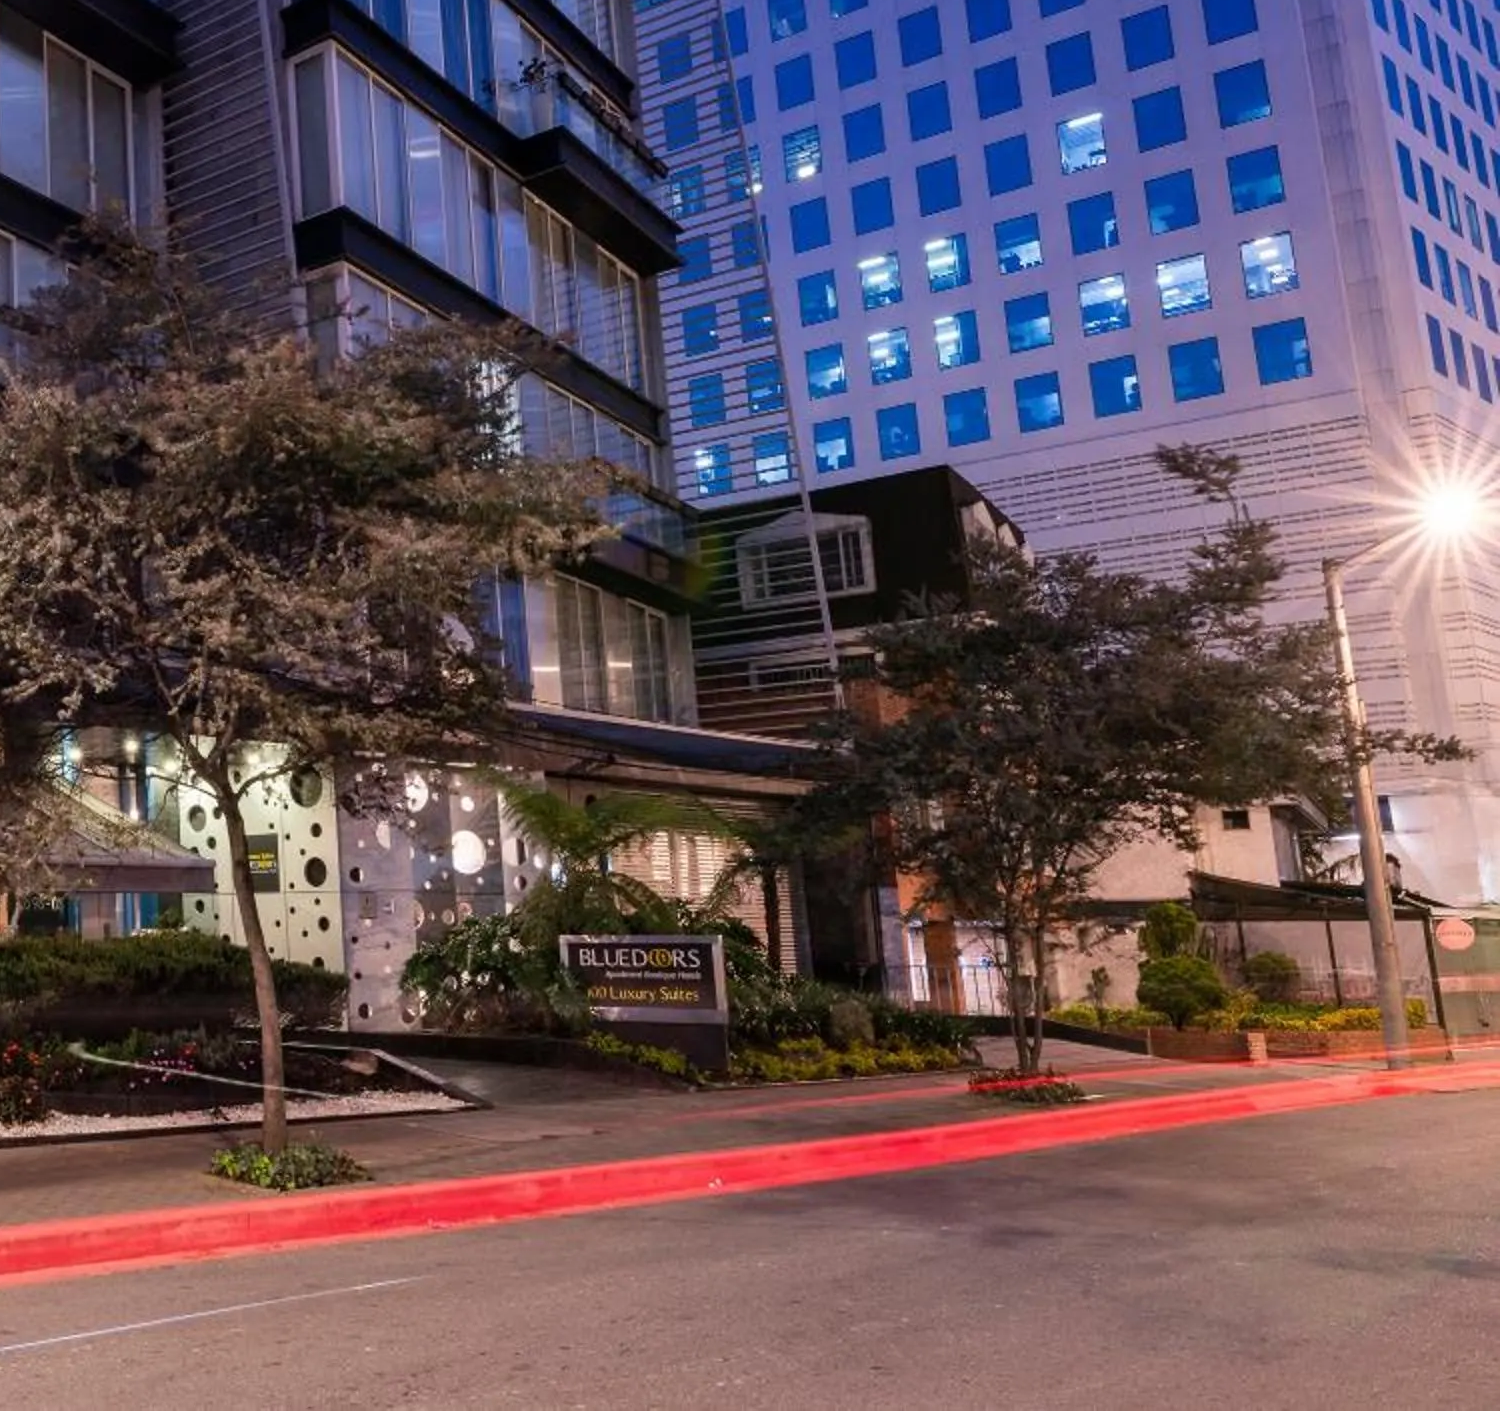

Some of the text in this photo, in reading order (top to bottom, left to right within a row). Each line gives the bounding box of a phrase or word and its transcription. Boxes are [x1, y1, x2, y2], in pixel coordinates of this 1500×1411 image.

[579, 948, 701, 968] BLUEDOORS
[609, 985, 656, 1004] Luxury
[659, 985, 700, 1002] Suites
